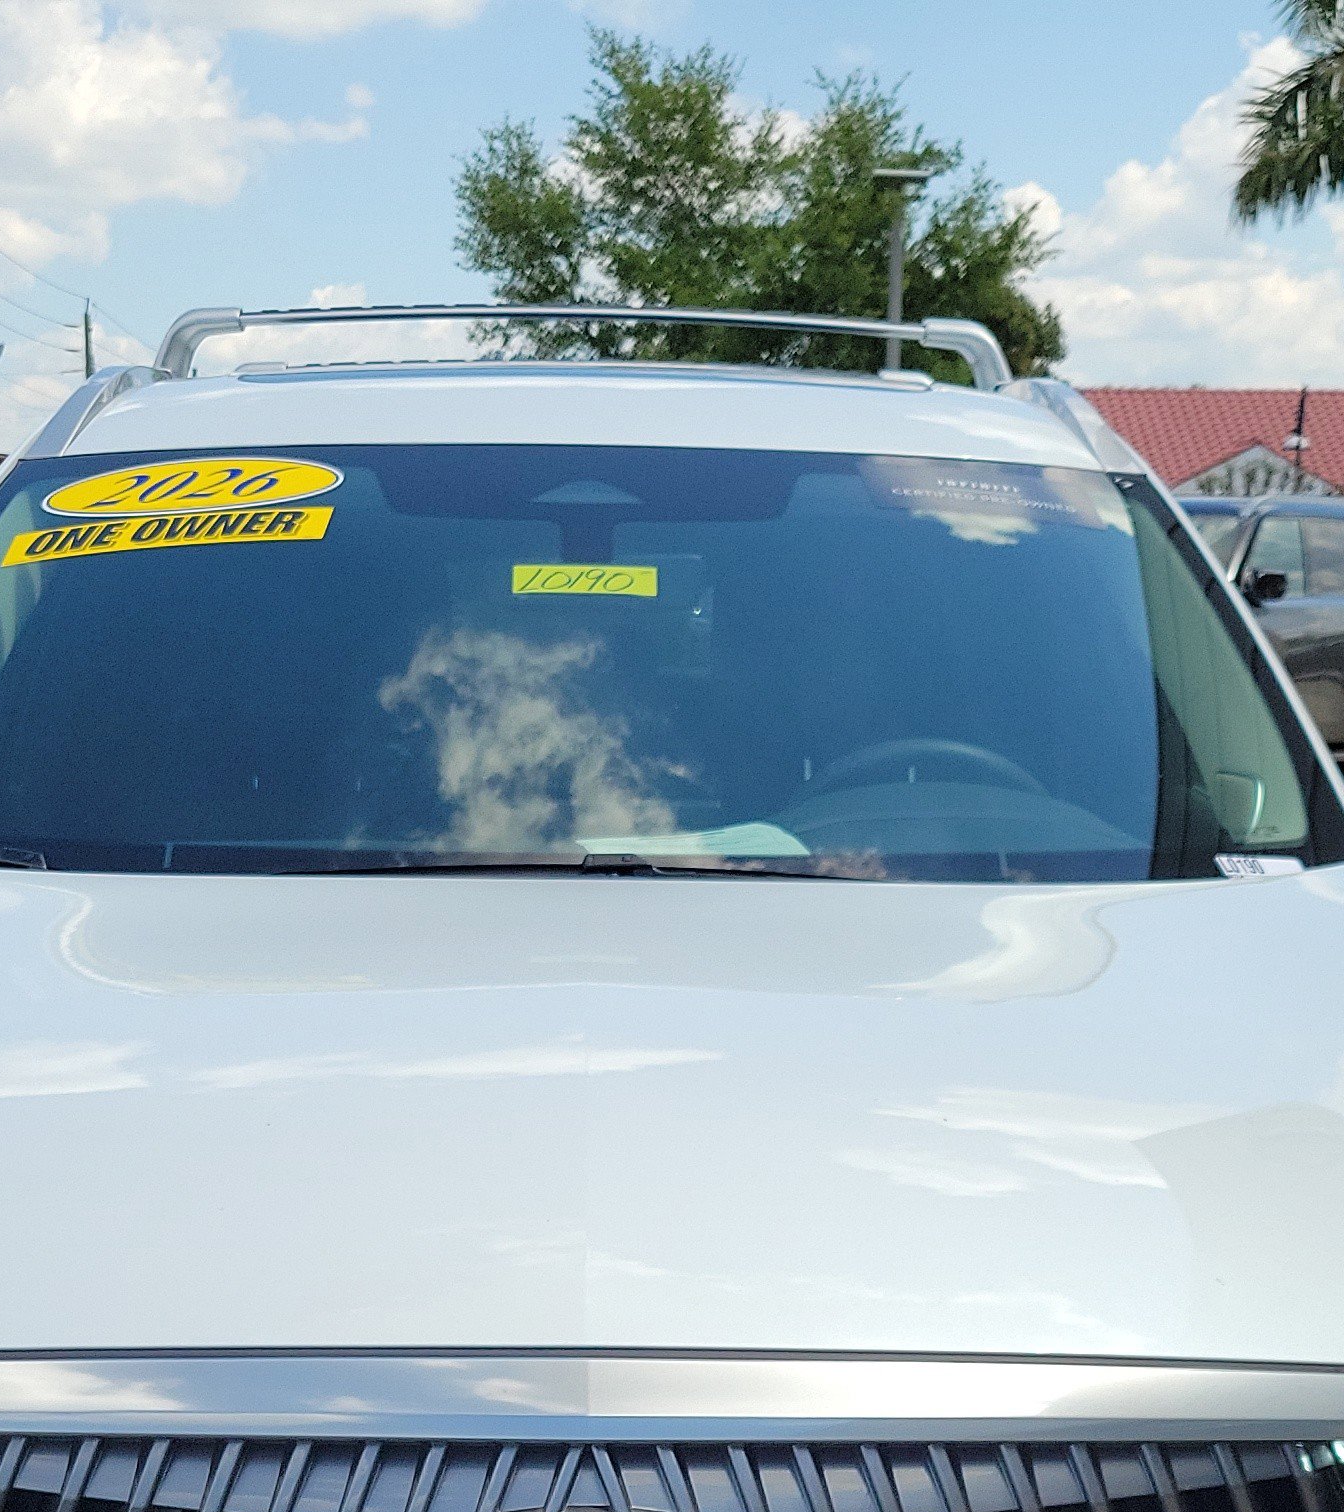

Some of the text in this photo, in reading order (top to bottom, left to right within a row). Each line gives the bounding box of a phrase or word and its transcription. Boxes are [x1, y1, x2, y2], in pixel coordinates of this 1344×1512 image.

[82, 467, 302, 509] 2026
[24, 510, 310, 557] ONE OWNER
